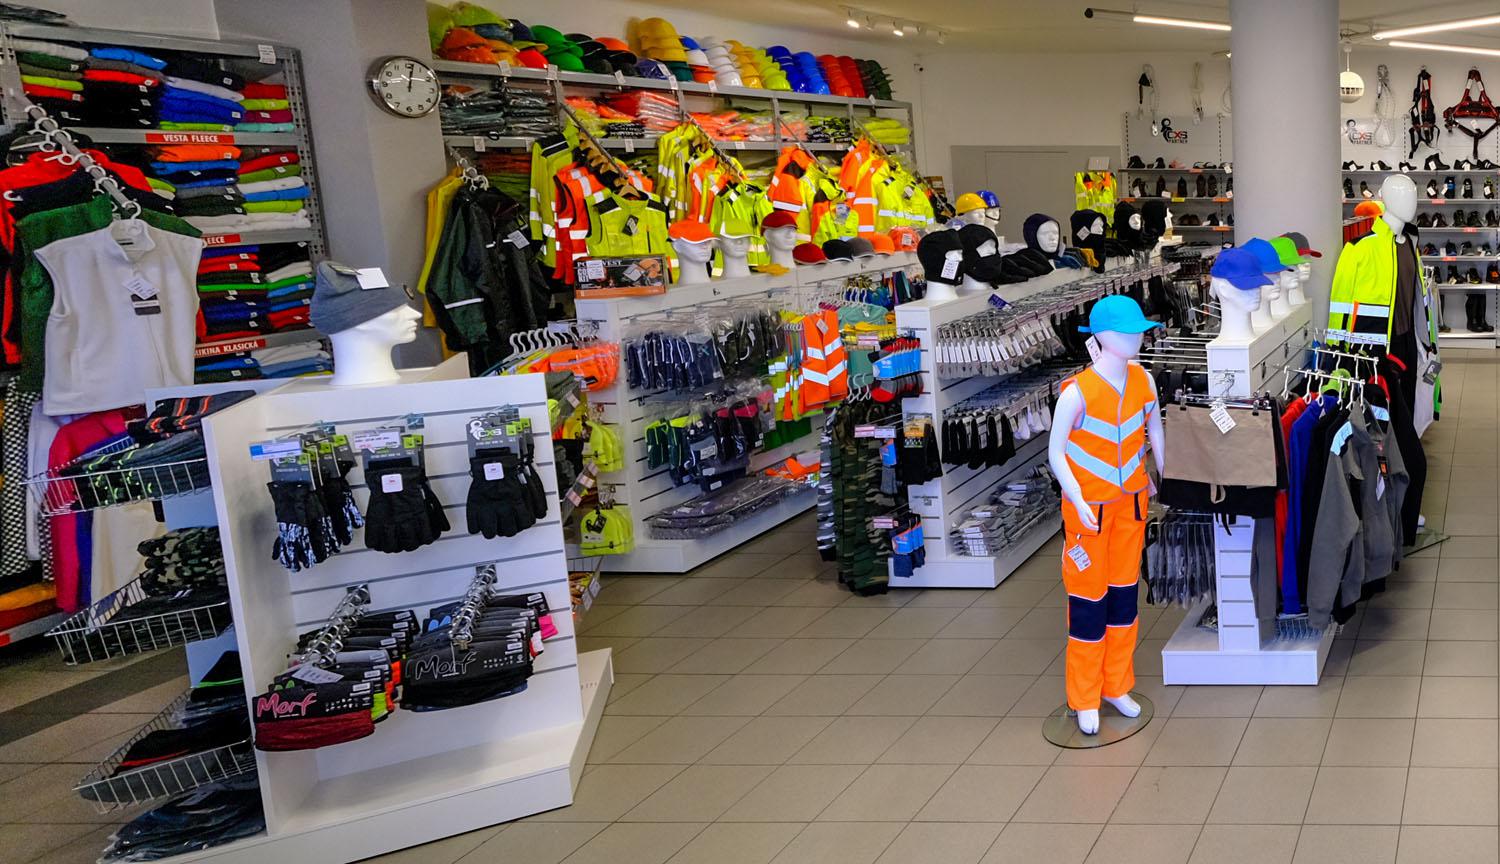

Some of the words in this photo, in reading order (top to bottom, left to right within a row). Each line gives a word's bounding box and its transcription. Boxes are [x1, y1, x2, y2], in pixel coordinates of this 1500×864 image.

[163, 134, 189, 142] VESTA
[191, 134, 219, 143] FLEECE
[478, 428, 502, 439] CXS
[415, 651, 478, 680] Morf
[256, 692, 318, 718] Morf
